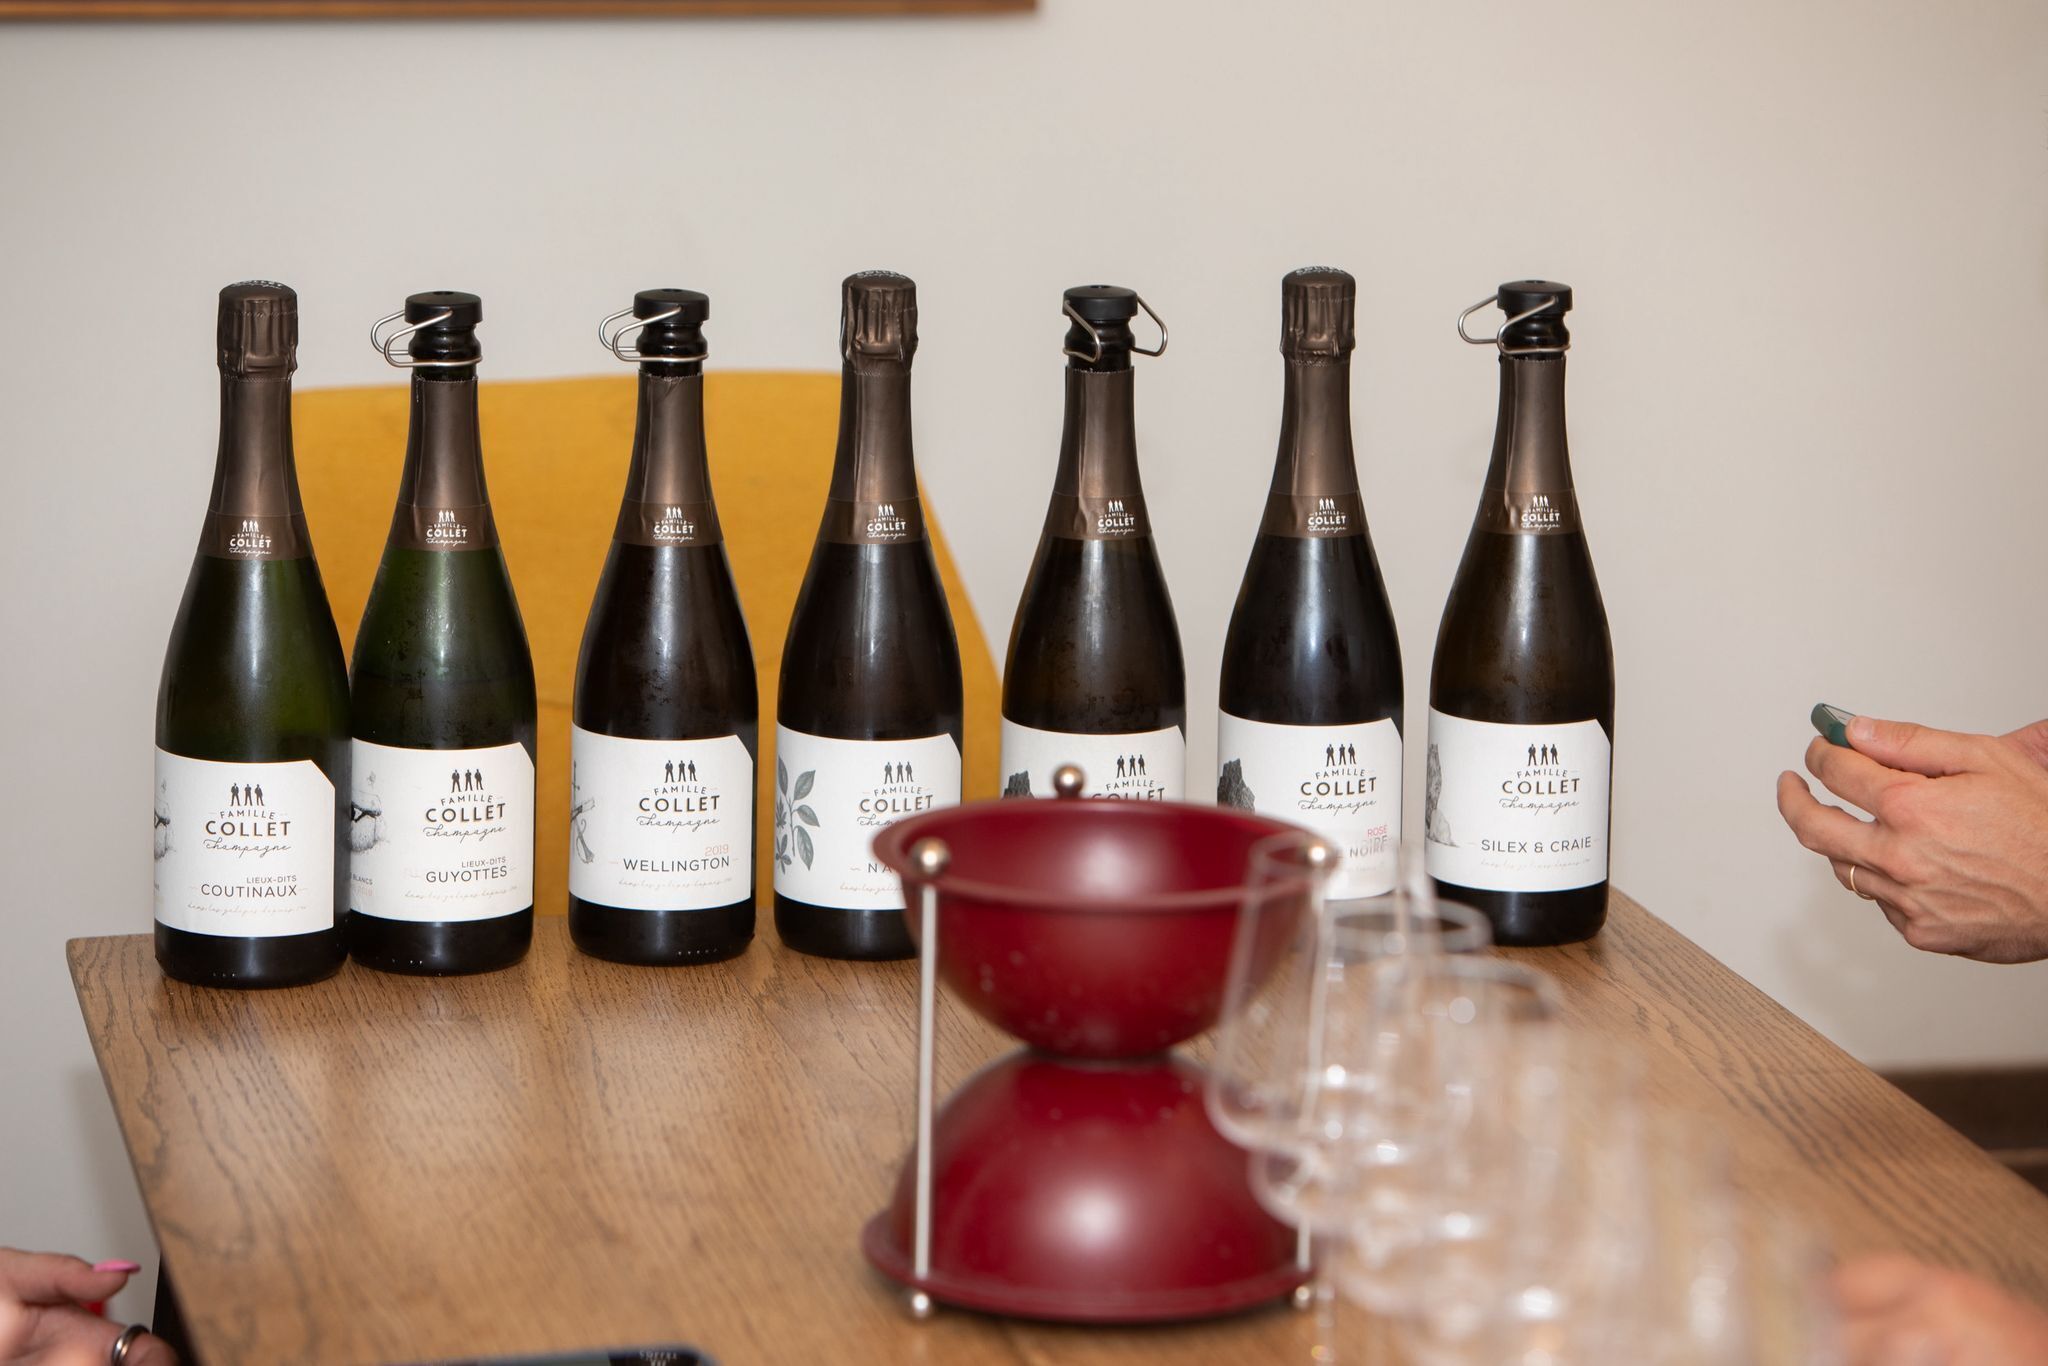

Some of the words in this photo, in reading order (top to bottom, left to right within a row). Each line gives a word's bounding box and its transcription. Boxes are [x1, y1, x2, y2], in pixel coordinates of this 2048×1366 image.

[1098, 517, 1135, 528] COLLET
[1308, 515, 1346, 525] COLLET
[1521, 512, 1560, 522] COLLET
[654, 525, 694, 534] COLLET
[867, 522, 906, 532] COLLET
[426, 529, 467, 538] COLLET
[230, 538, 272, 548] COLLET
[1315, 768, 1366, 780] FAMILLE
[1517, 769, 1568, 779] FAMILLE
[654, 785, 707, 796] FAMILLE
[874, 786, 922, 797] FAMILLE
[1105, 780, 1155, 791] FAMILLE
[1301, 777, 1377, 796] COLLET
[1502, 778, 1580, 795] COLLET
[441, 794, 493, 806] FAMILLE
[639, 795, 720, 812] COLLET
[860, 795, 934, 813] COLLET
[220, 809, 275, 820] FAMILLE
[426, 803, 506, 823] COLLET
[205, 820, 291, 837] COLLET
[704, 844, 729, 857] 2019
[1481, 839, 1528, 854] SILEX
[1534, 842, 1544, 854] &
[1550, 836, 1592, 853] CRAIE
[461, 856, 506, 868] LIEUX-DITS
[623, 856, 730, 872] WELLINGTON
[246, 875, 297, 884] LIEUX-DITS
[426, 865, 508, 883] GUYOTTES
[201, 883, 297, 898] COUTINAUX
